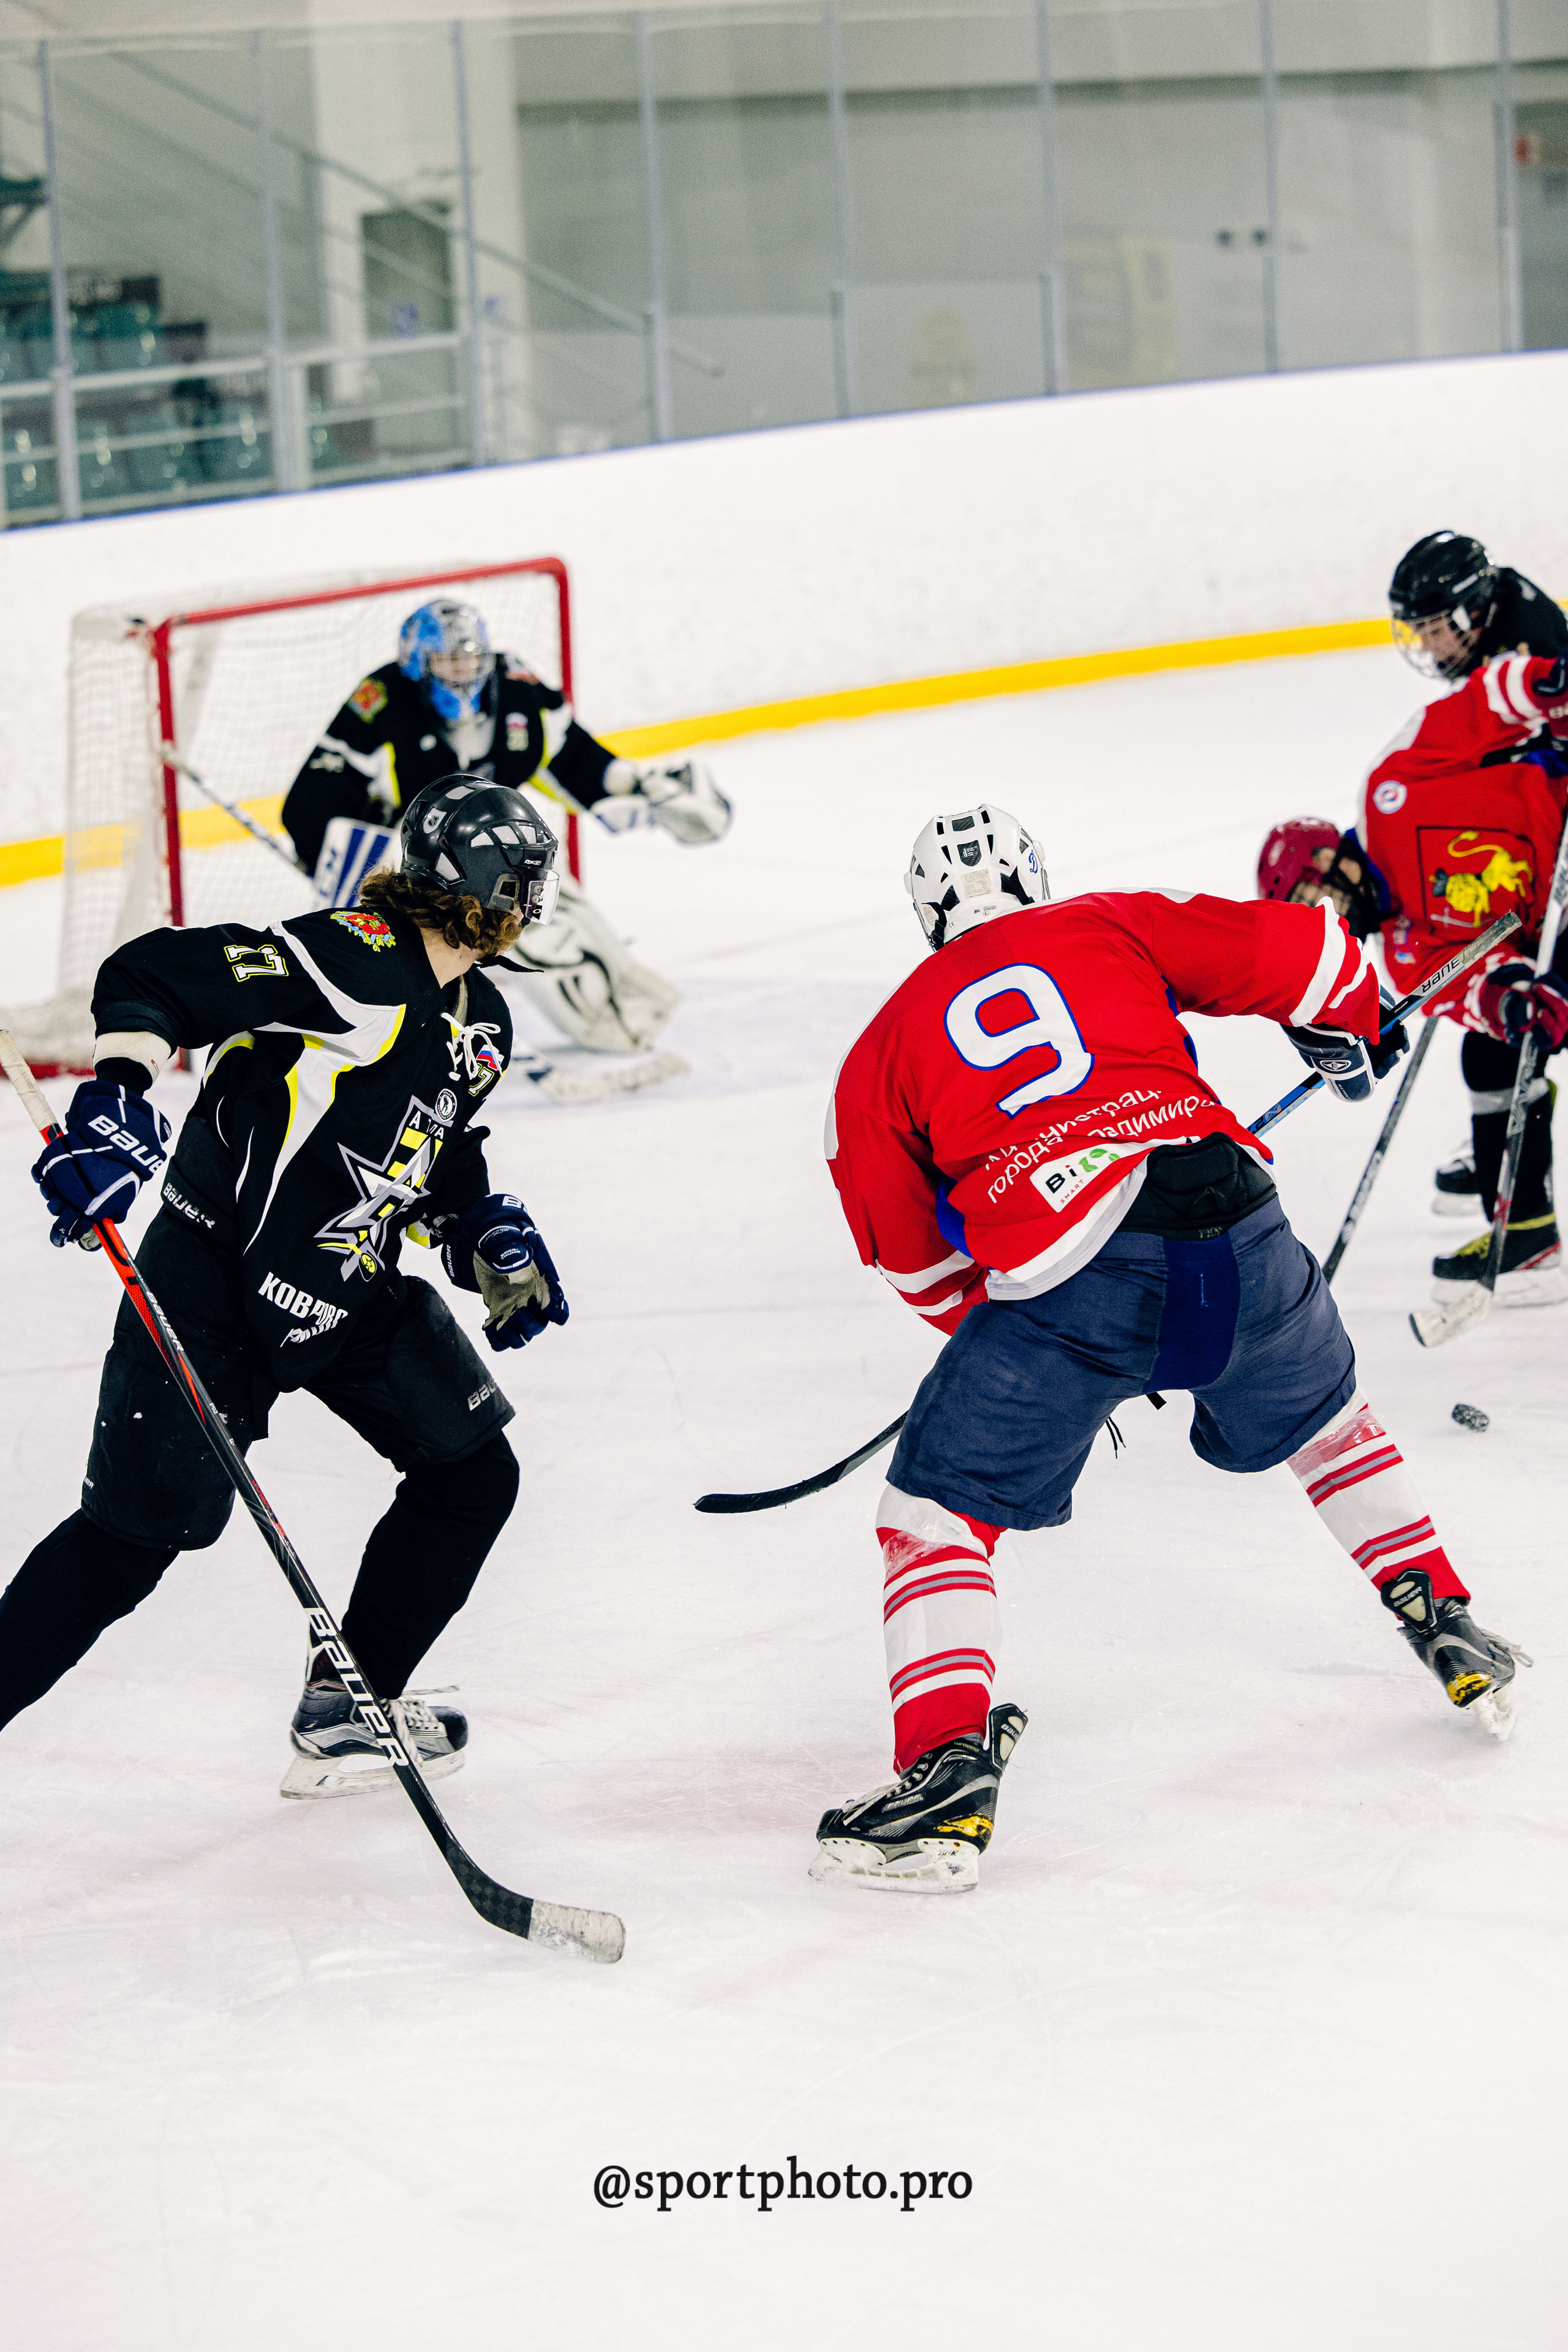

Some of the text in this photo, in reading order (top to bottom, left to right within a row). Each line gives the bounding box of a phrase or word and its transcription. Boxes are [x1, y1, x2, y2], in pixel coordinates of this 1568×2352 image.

[224, 944, 288, 982] 17
[1422, 957, 1461, 993] AUER
[944, 962, 1095, 1120] 9
[88, 1114, 165, 1174] BAUE
[1060, 1178, 1084, 1204] SMART
[446, 1244, 455, 1278] BAUER
[146, 1291, 184, 1352] BAUER
[467, 1382, 497, 1411] BAU
[303, 1607, 409, 1767] BAUER
